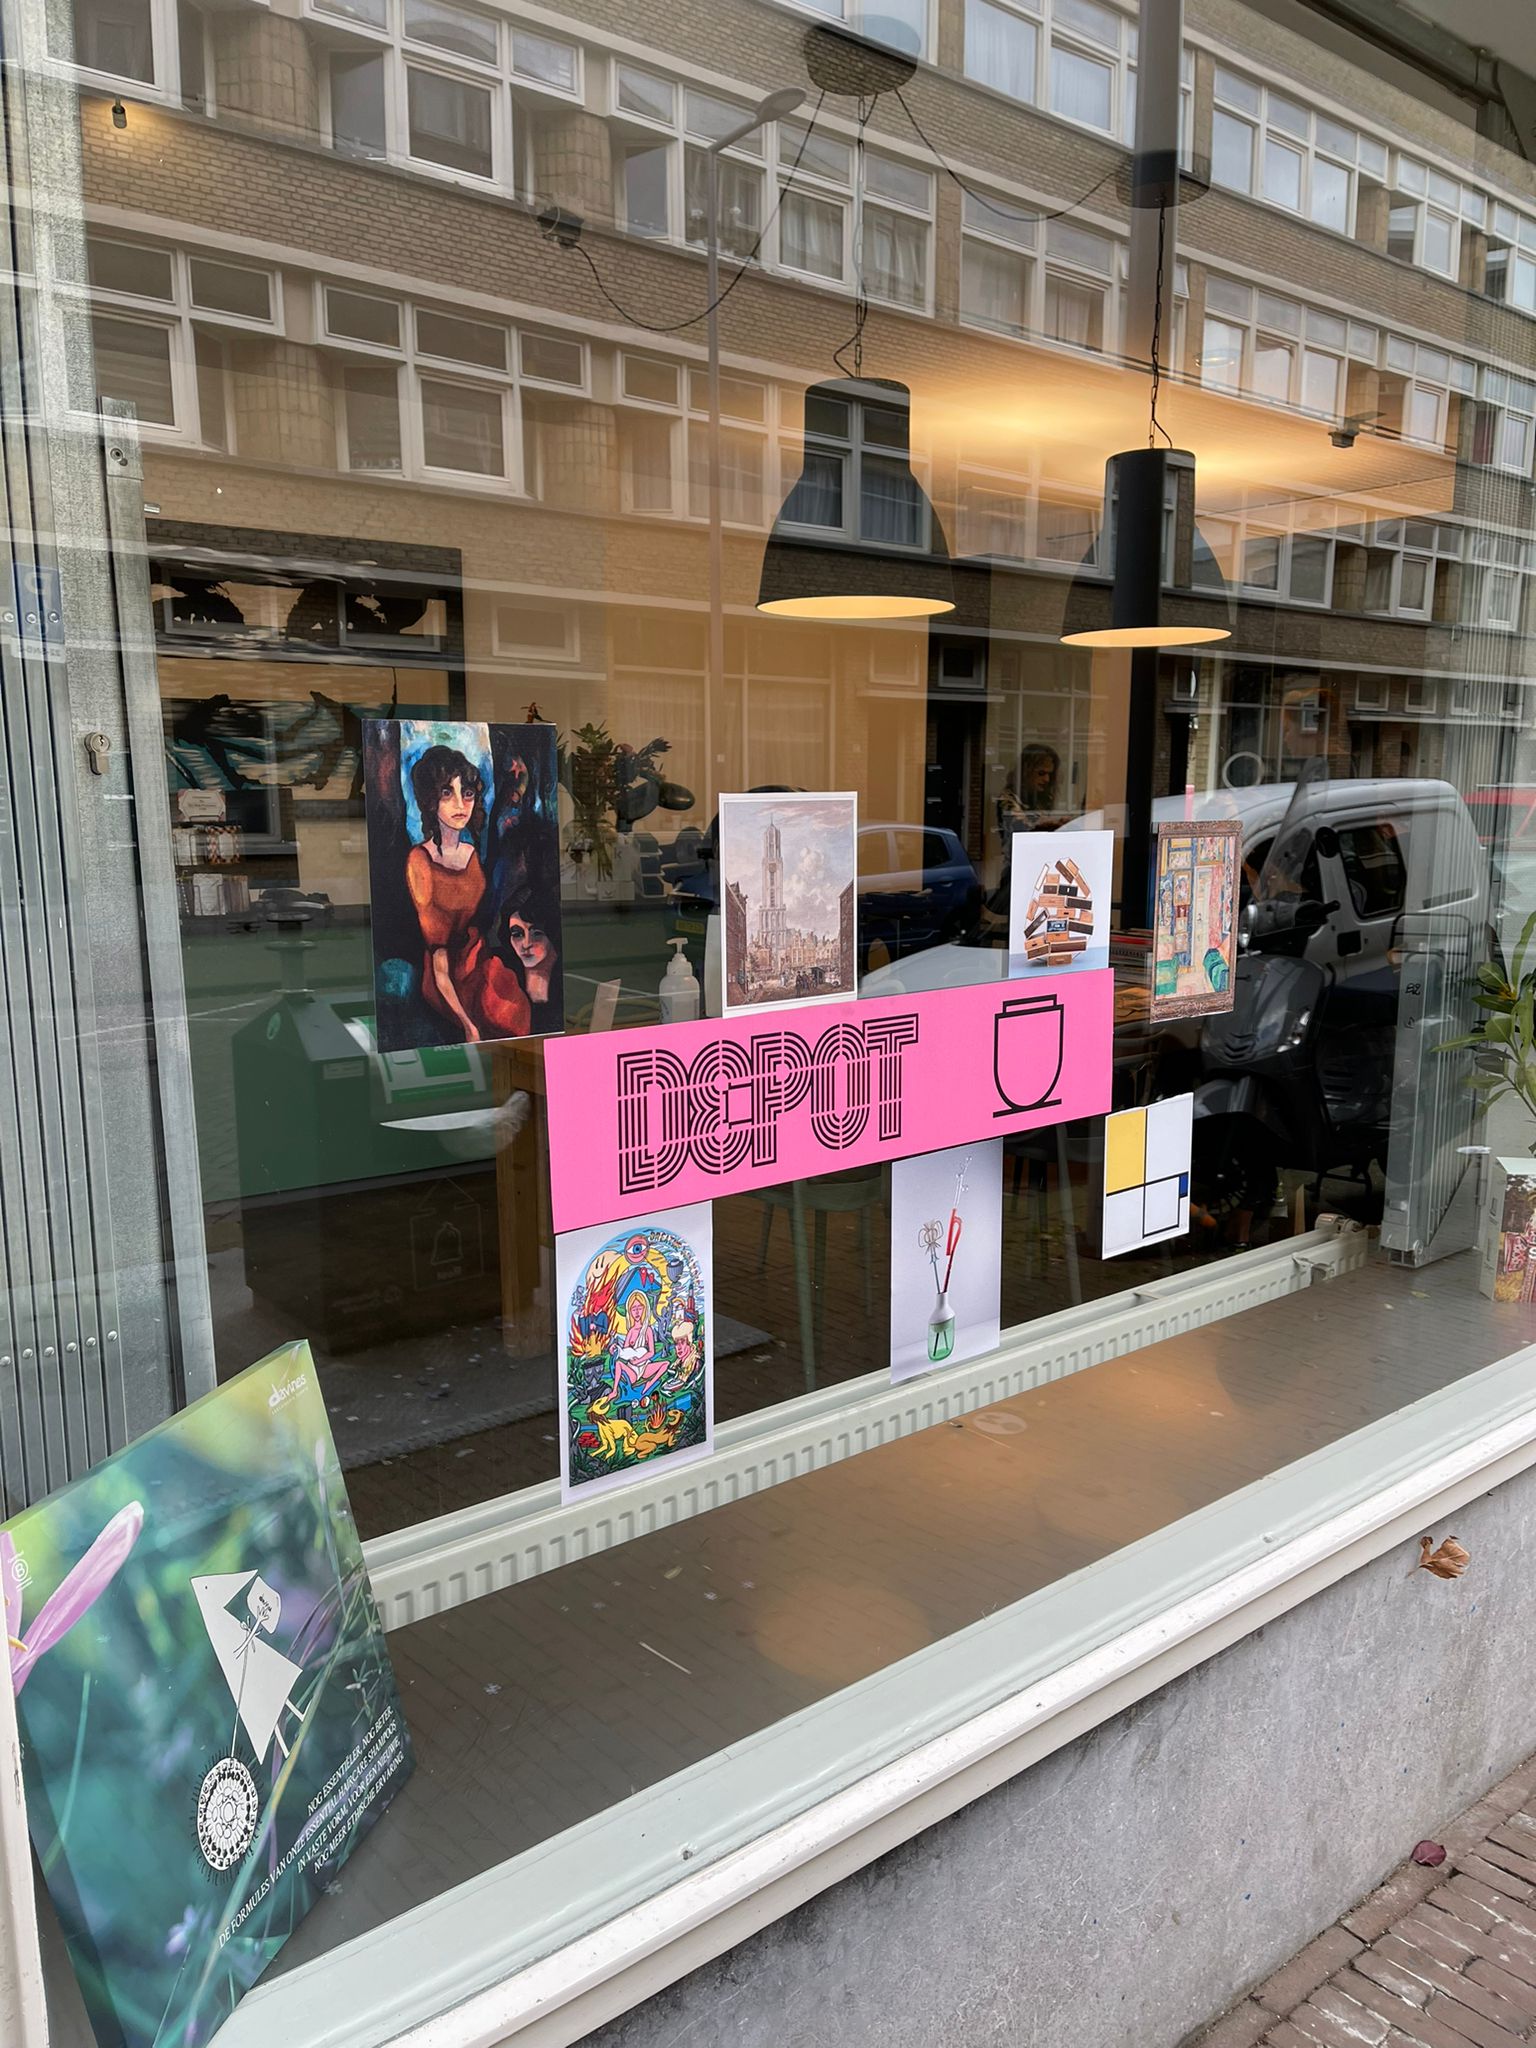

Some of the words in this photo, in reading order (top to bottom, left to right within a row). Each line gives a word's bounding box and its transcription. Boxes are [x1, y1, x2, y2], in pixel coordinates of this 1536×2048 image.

[617, 1013, 919, 1196] DEPOT
[269, 1374, 306, 1407] davines
[297, 1855, 306, 1874] IN
[305, 1829, 328, 1861] VASTE
[347, 1781, 366, 1807] VOOR
[365, 1764, 378, 1786] EEN
[307, 1791, 323, 1816] NOG
[362, 1726, 376, 1749] NOG
[218, 1927, 231, 1949] DE
[230, 1878, 270, 1934] FORMULES
[269, 1857, 287, 1883] VAN
[285, 1834, 306, 1864] ONZE
[305, 1794, 340, 1841] ESSENTIAL
[338, 1755, 368, 1801] HAIRCARE
[314, 1847, 330, 1874] NOG
[329, 1825, 347, 1854] MEER
[346, 1786, 376, 1832] ETHISCHE
